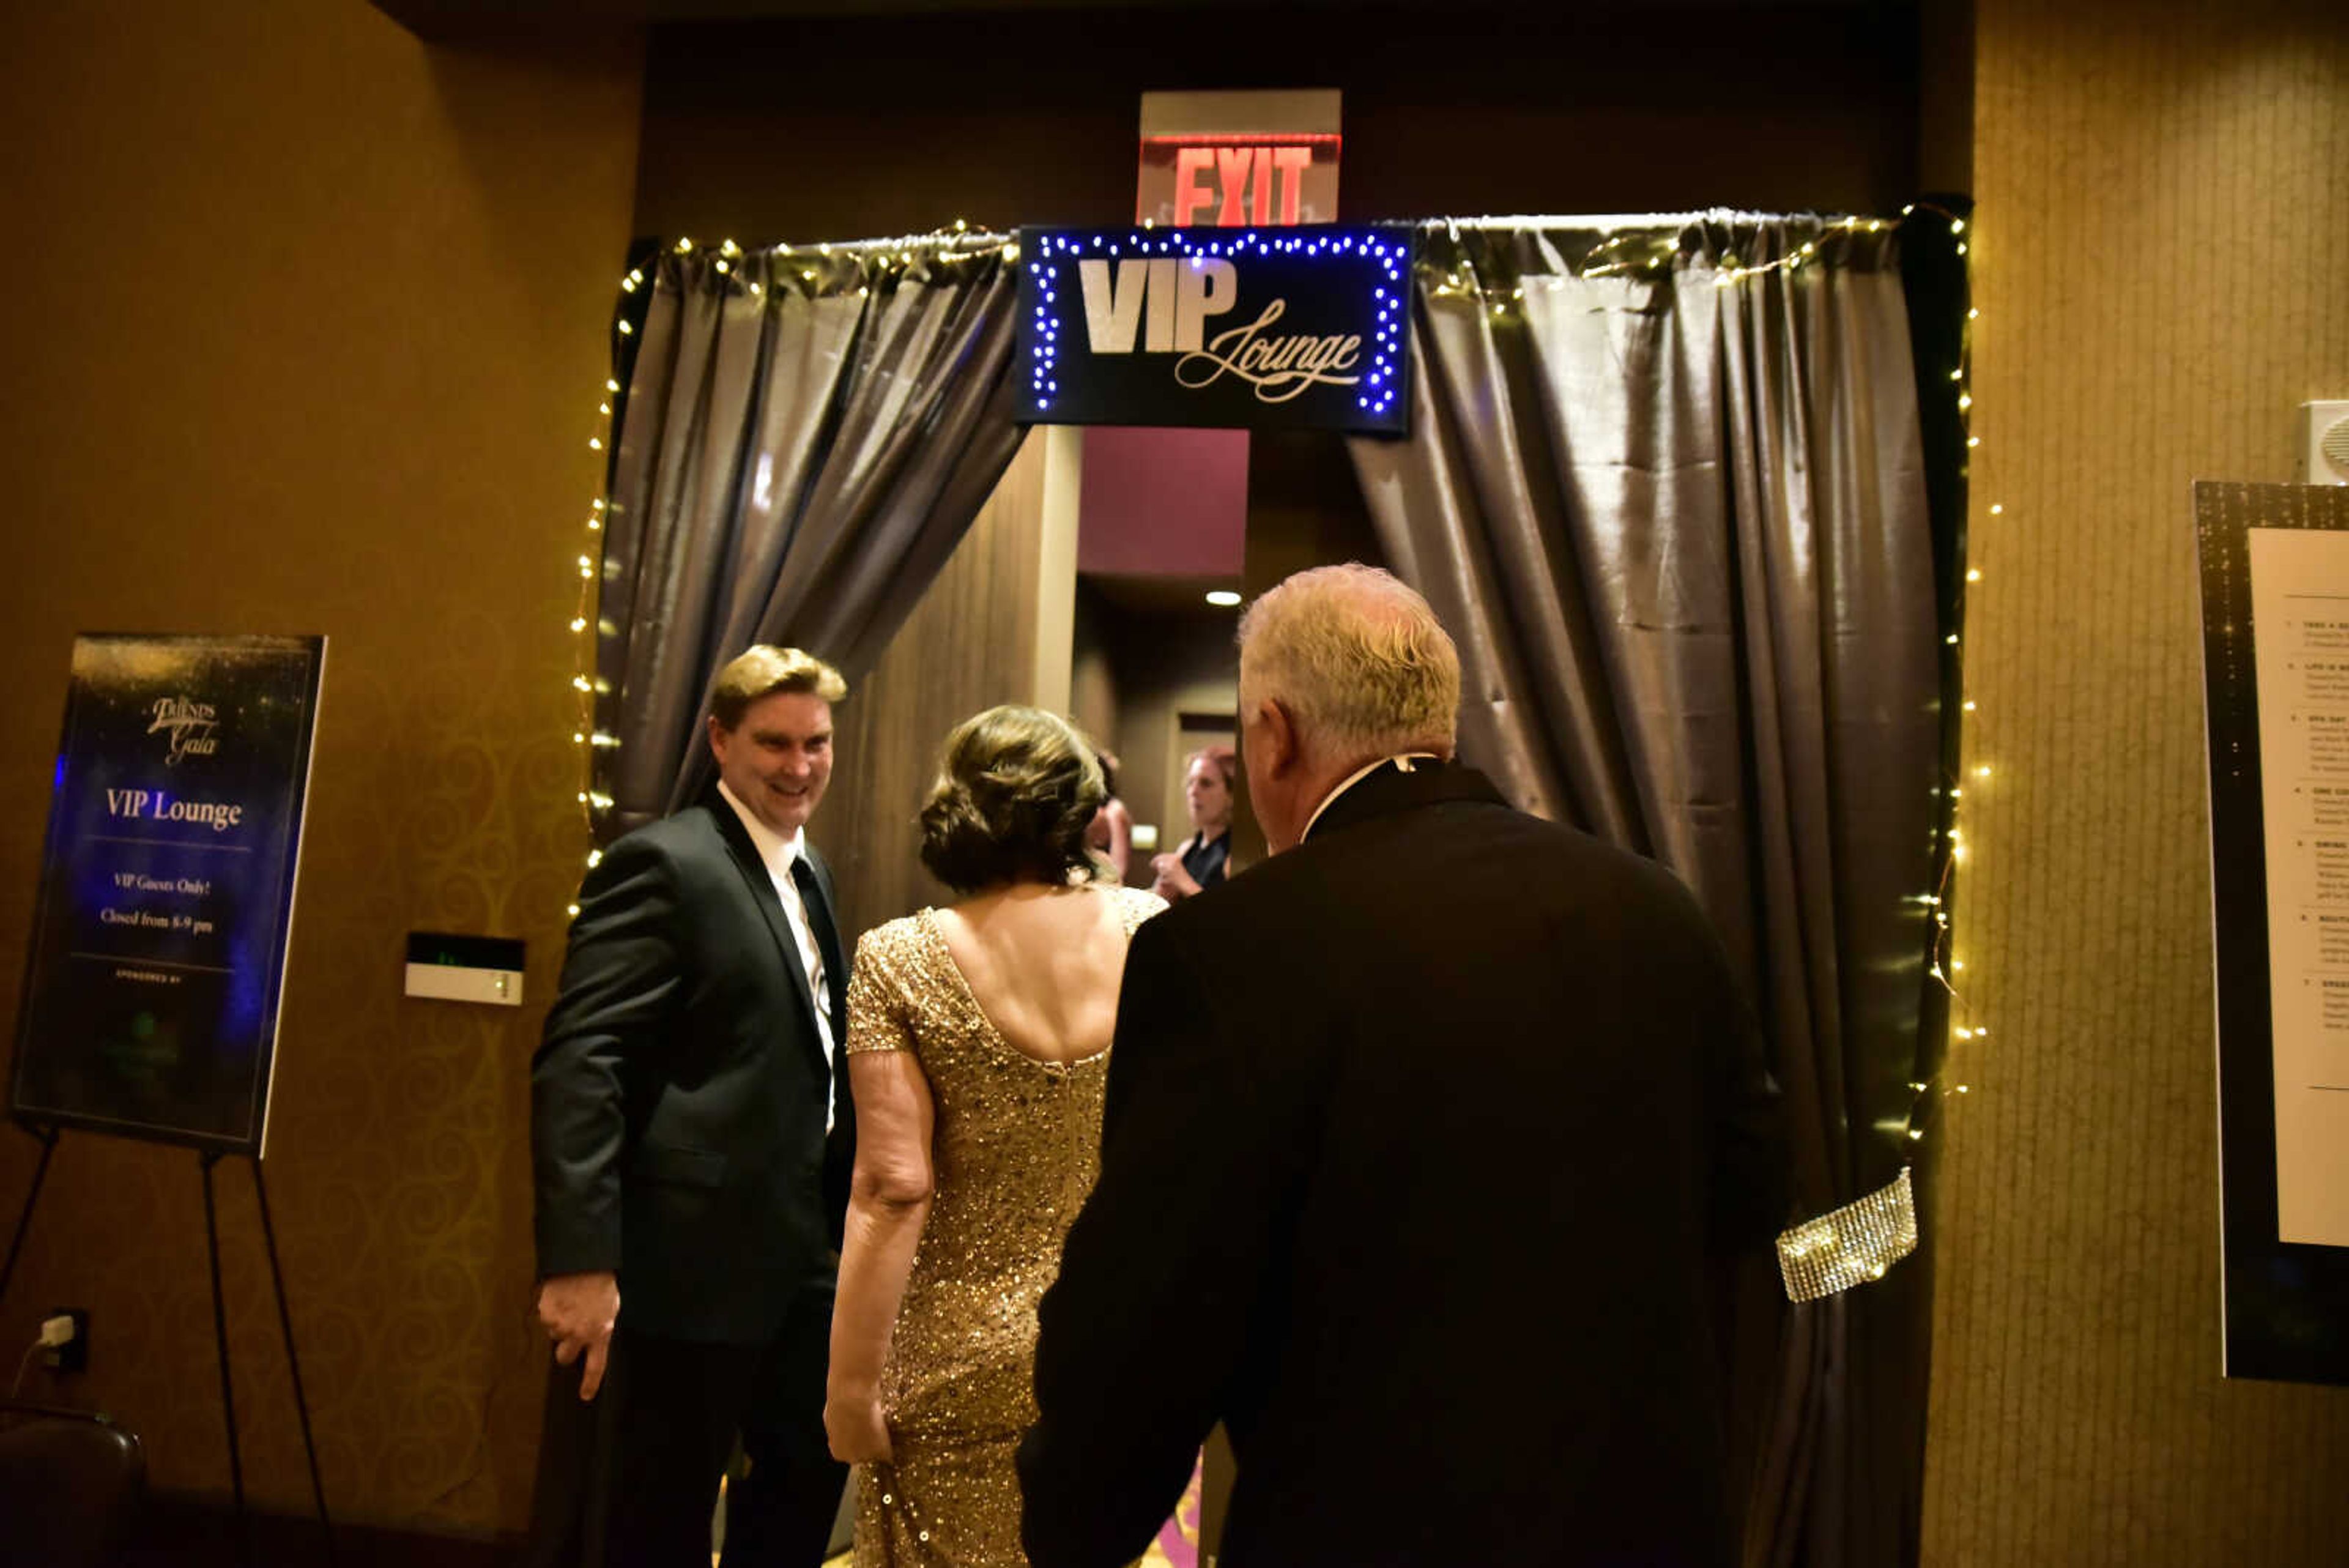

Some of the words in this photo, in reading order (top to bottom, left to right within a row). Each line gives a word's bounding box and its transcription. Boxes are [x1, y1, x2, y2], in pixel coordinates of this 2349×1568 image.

[1174, 147, 1312, 227] EXIT
[1078, 258, 1237, 353] VIP
[1175, 299, 1362, 403] Lounge
[106, 788, 149, 817] VIP
[154, 790, 242, 832] Lounge
[114, 872, 136, 888] VIP
[137, 875, 174, 891] Guests
[100, 908, 139, 926] Closed
[141, 912, 169, 929] from
